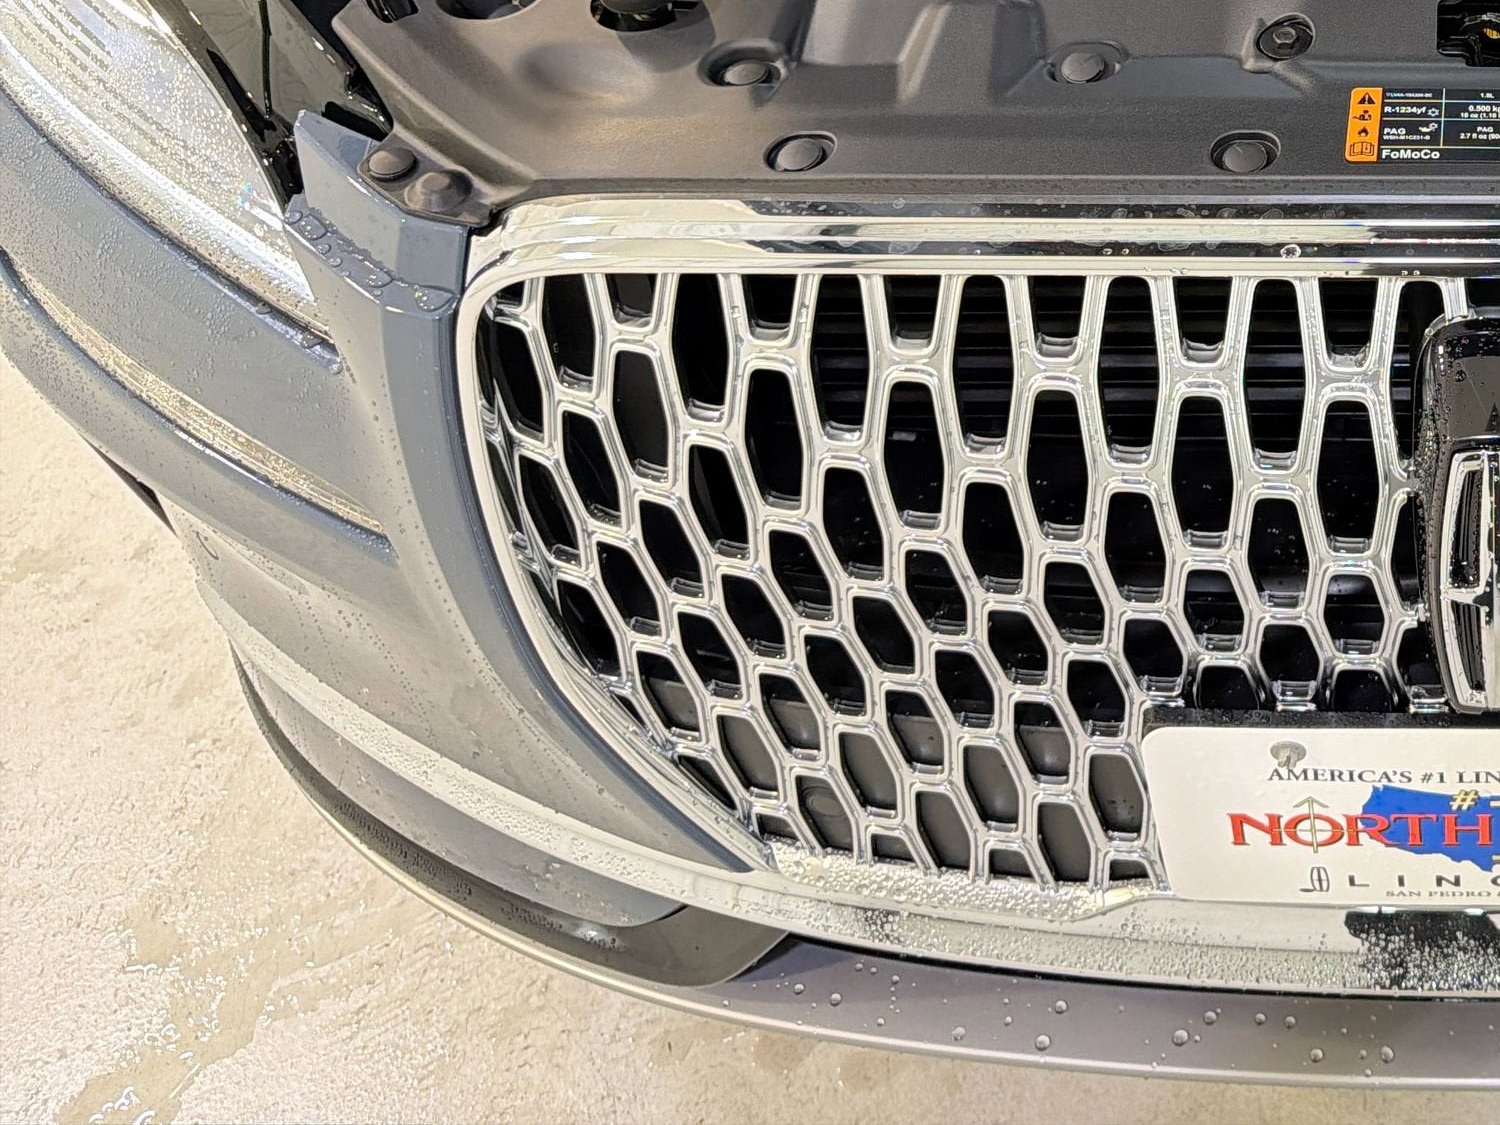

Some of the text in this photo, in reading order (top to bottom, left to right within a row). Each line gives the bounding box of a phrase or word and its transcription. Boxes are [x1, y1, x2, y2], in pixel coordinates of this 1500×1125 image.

[1383, 105, 1427, 115] R-1234yf
[1468, 104, 1491, 112] 0.500
[1383, 127, 1406, 135] PAG
[1381, 149, 1440, 159] FoMoCo
[1267, 768, 1413, 784] AMERICA'S
[1420, 770, 1447, 784] #1
[1227, 812, 1494, 847] NORTH
[1385, 890, 1422, 898] SAN
[1428, 890, 1492, 898] PEDRO
